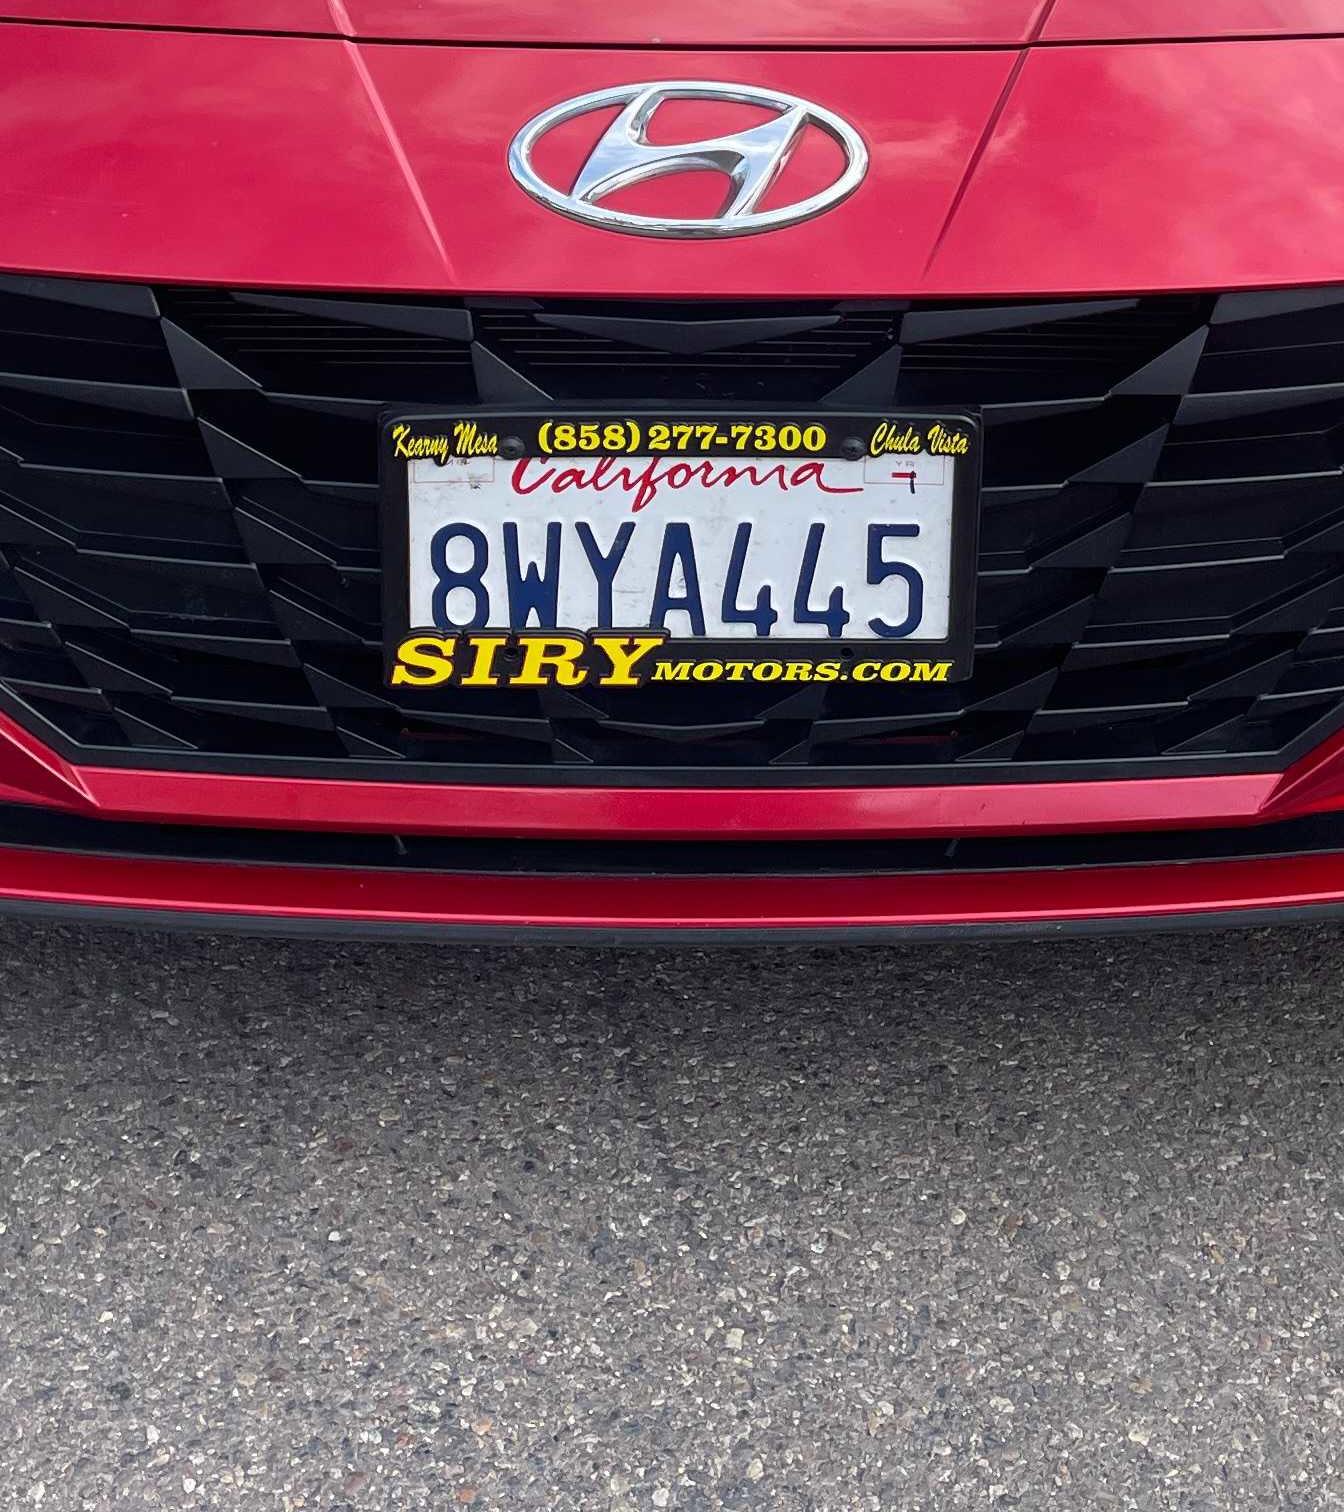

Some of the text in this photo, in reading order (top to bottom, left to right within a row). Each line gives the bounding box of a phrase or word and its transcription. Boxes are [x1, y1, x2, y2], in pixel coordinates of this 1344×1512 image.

[392, 422, 498, 464] Kearny Mesa
[539, 422, 827, 454] (858) 277-7300
[870, 422, 969, 456] Chula Vista
[512, 457, 864, 513] California
[430, 521, 924, 638] 8WYA445
[391, 637, 955, 687] SIRY MOTORS.COM
